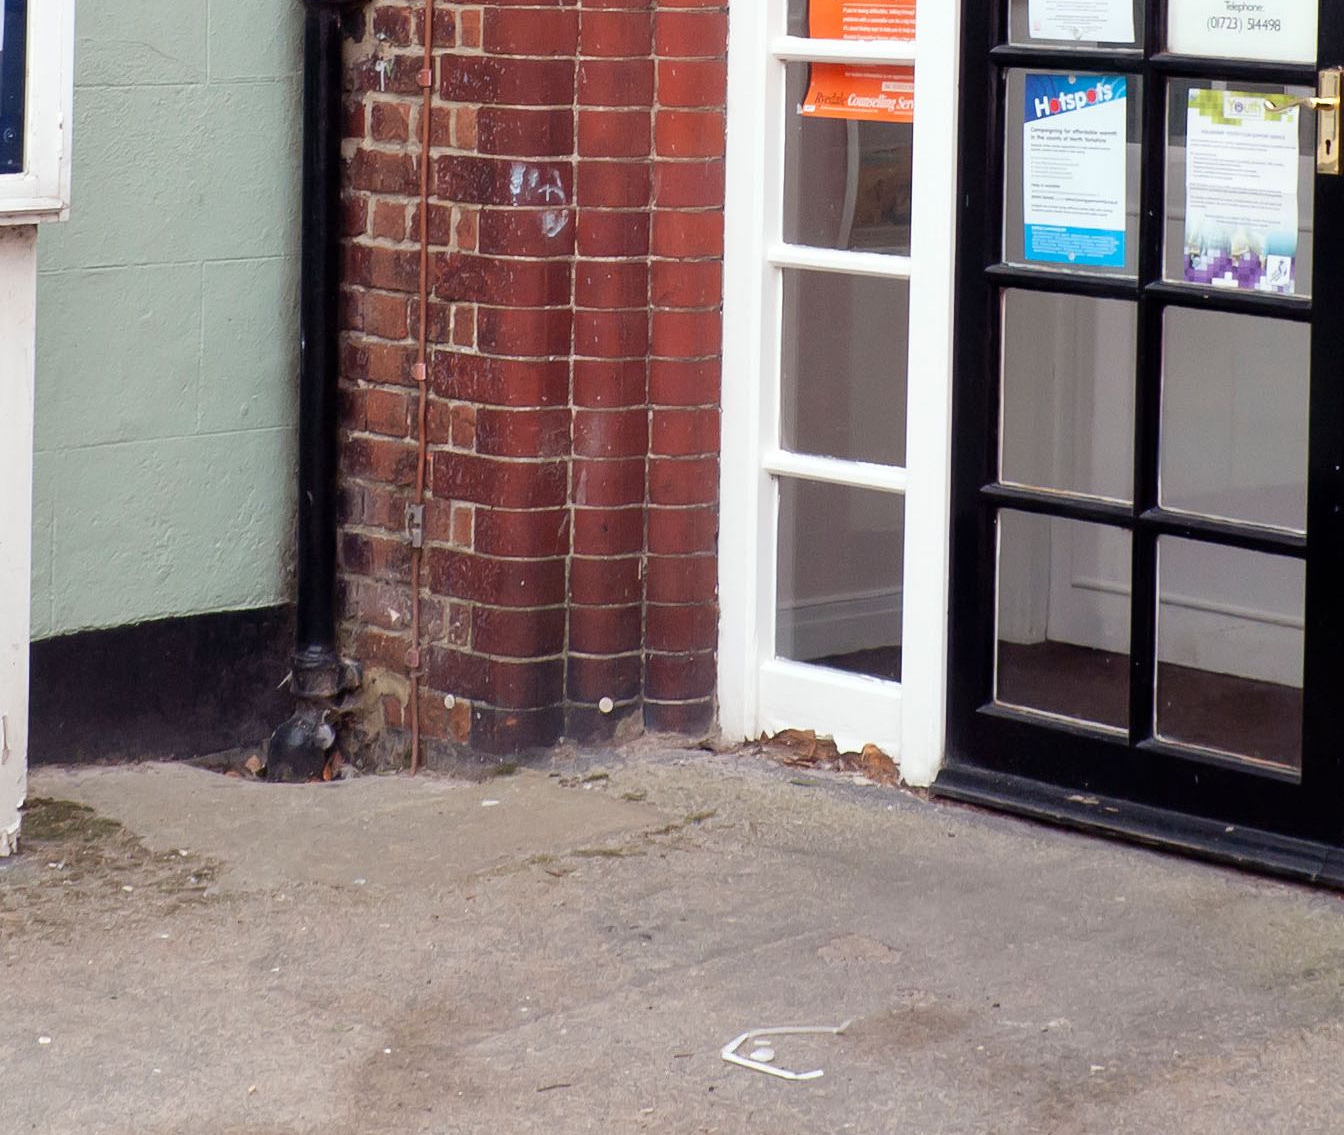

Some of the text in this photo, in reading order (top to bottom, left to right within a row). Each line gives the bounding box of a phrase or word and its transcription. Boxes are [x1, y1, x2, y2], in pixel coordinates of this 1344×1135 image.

[1207, 16, 1281, 33] (01723) 514498
[847, 92, 896, 113] Counselling
[1034, 82, 1113, 118] Hotspots
